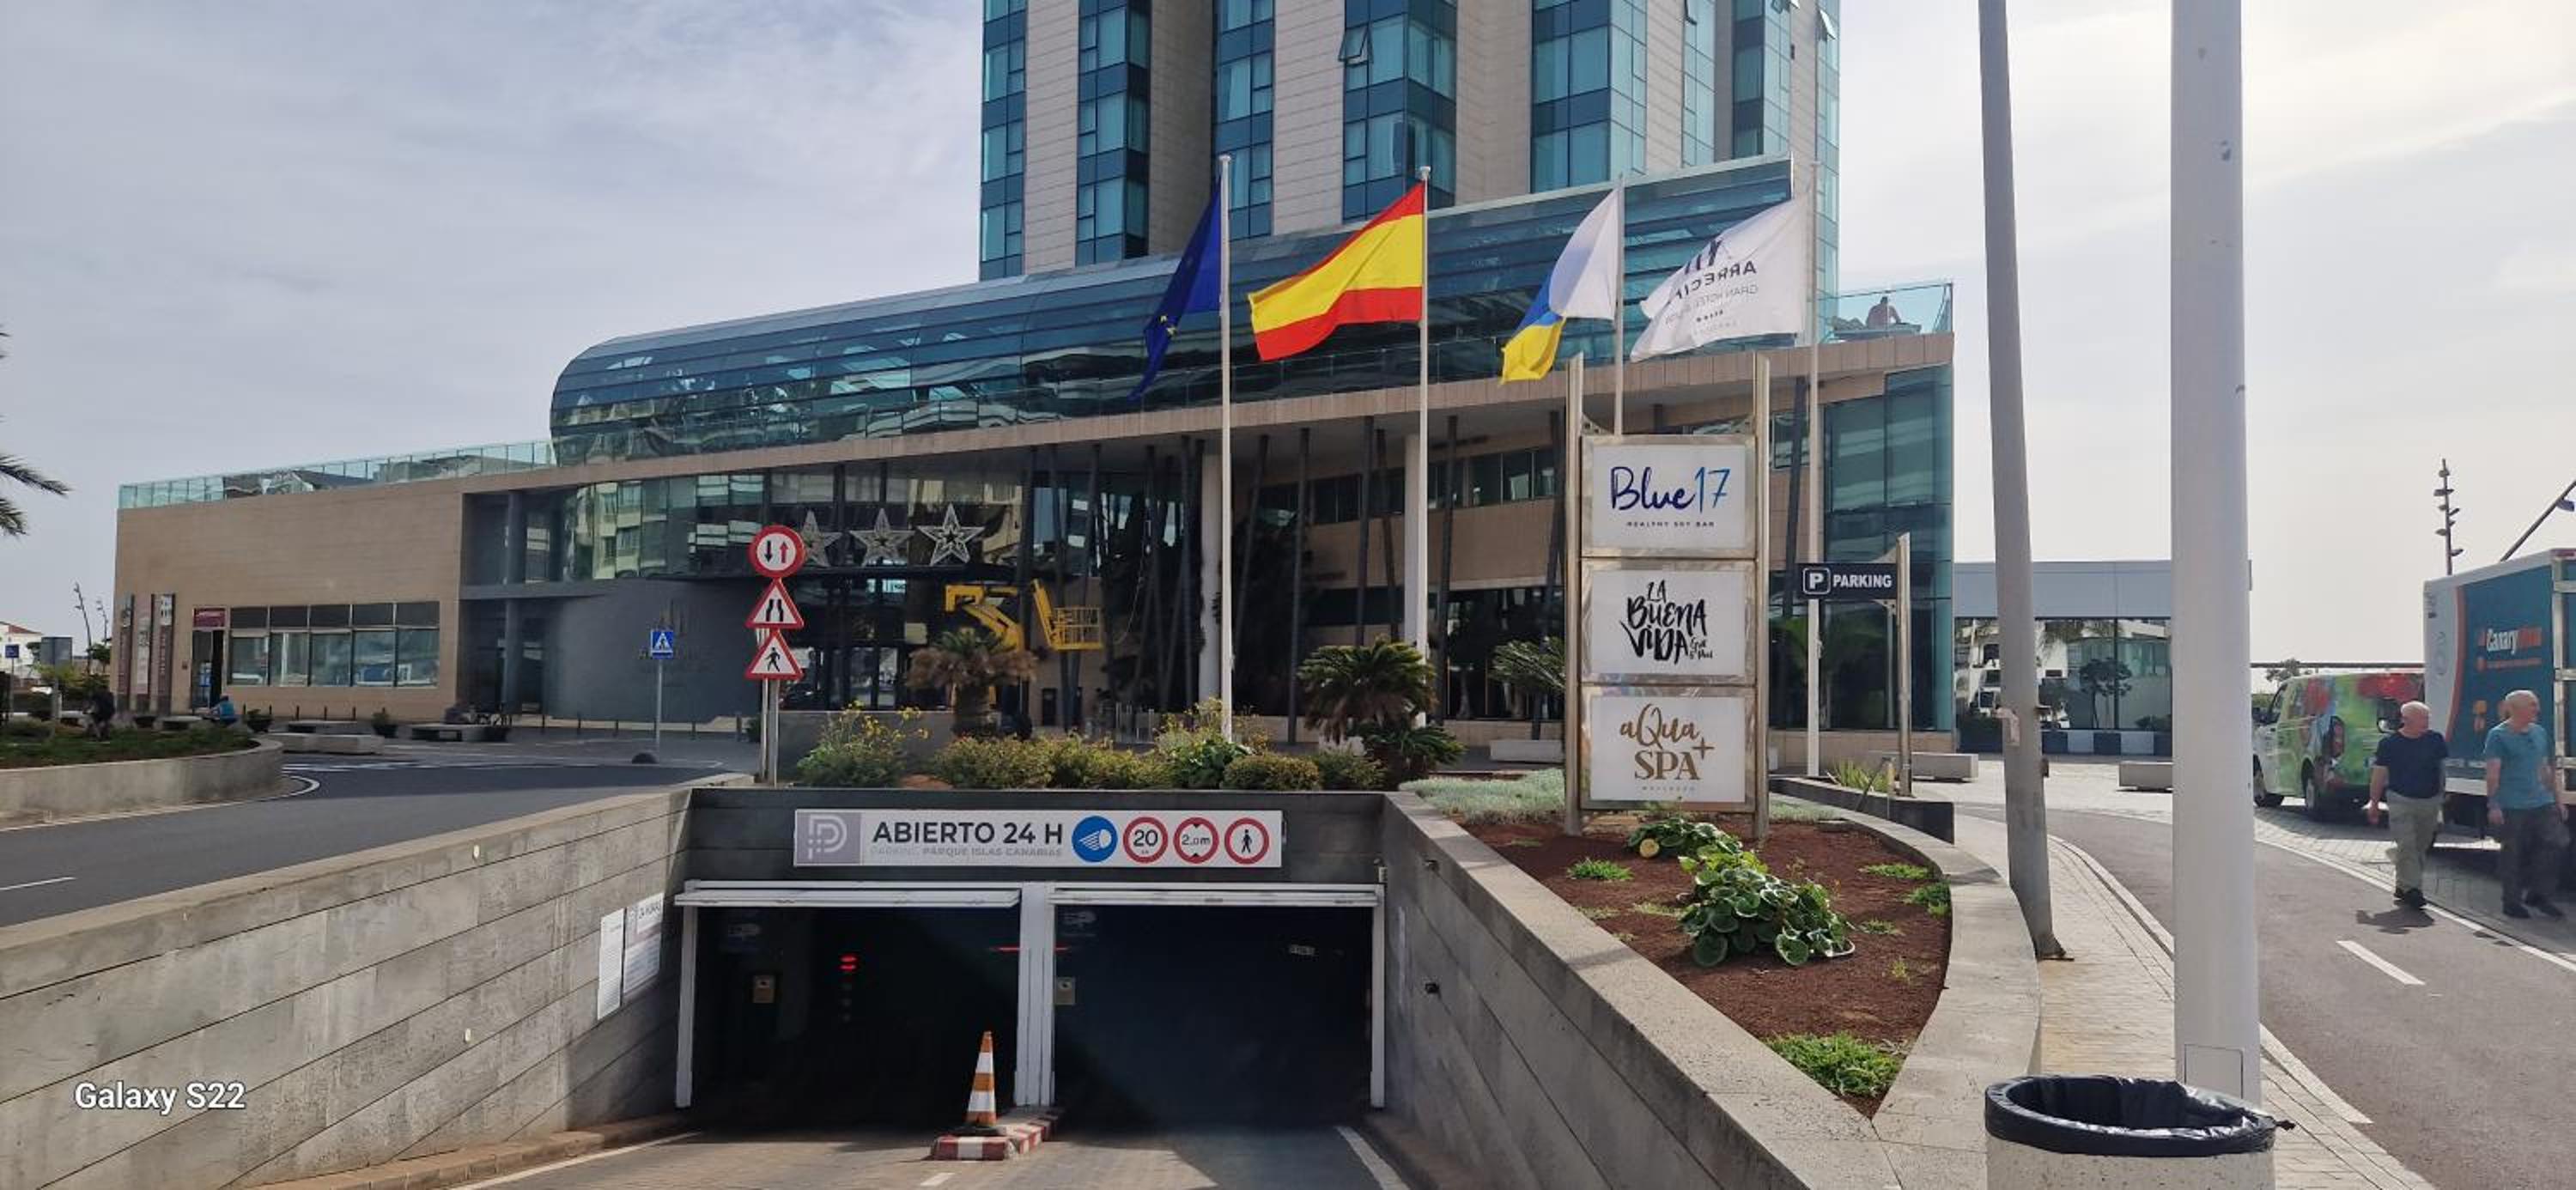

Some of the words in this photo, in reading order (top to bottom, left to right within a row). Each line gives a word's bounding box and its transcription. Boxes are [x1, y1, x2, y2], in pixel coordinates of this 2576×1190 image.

[1648, 579, 1667, 604] LA
[1808, 572, 1824, 590] P
[1832, 574, 1893, 588] PARKING
[1634, 750, 1701, 780] SPA
[872, 822, 996, 844] ABIERTO
[1003, 822, 1036, 844] 24
[1045, 823, 1063, 845] H
[1133, 829, 1159, 847] 20
